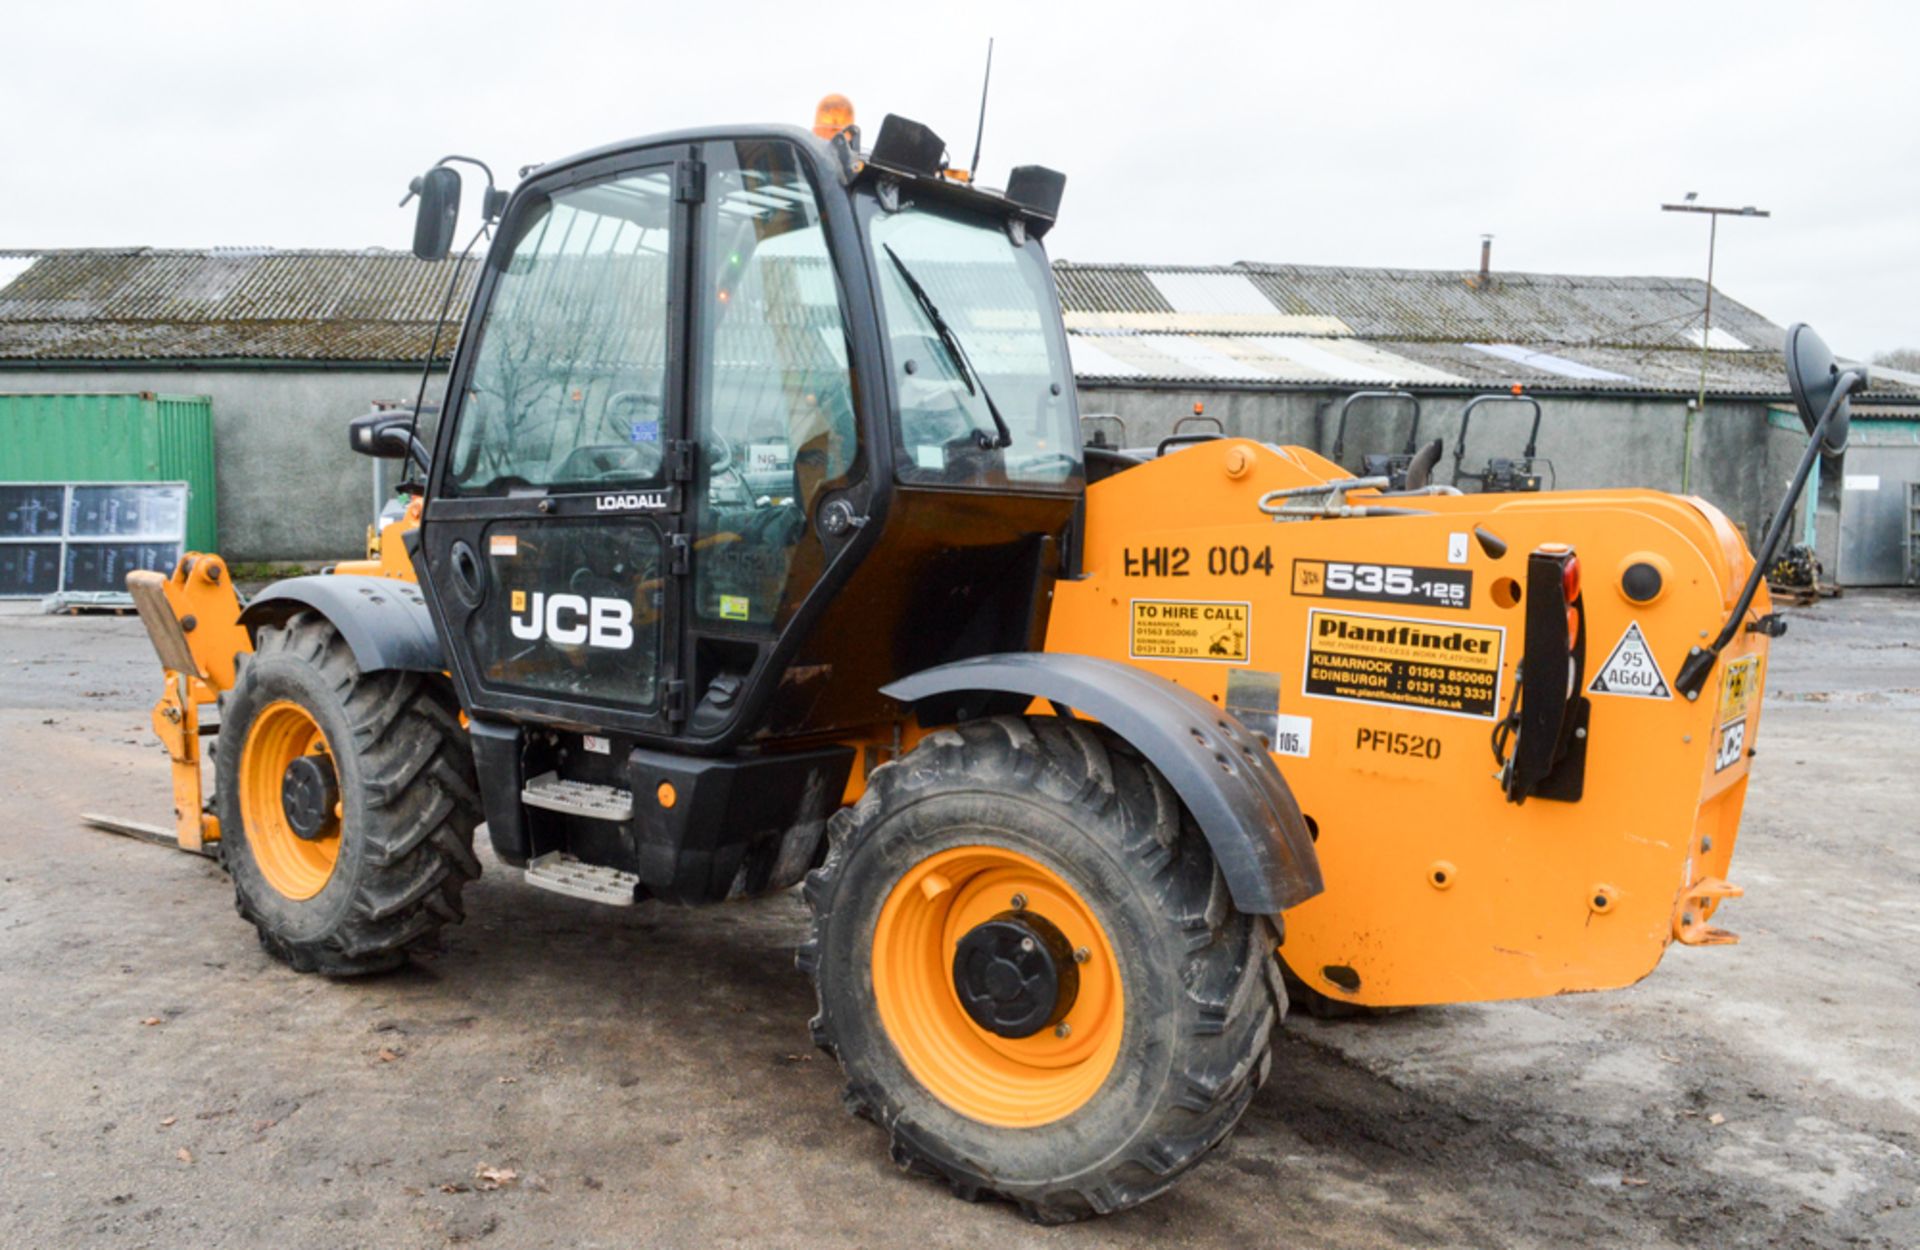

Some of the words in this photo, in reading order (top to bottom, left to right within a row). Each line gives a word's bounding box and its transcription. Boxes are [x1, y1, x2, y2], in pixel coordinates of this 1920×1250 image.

[596, 494, 667, 510] LOADALL
[1208, 545, 1274, 577] 004
[511, 592, 634, 650] JCB
[1137, 606, 1158, 618] TO
[1162, 606, 1199, 619] HIRE
[1203, 607, 1243, 621] CALL
[1136, 627, 1163, 636] 01563
[1318, 618, 1492, 655] Plantfinder
[1312, 654, 1393, 674] KILMARNOCK
[1408, 665, 1445, 679] 01563
[1448, 669, 1494, 686] 850060
[1622, 651, 1643, 668] 95
[1311, 668, 1388, 688] EDINBURGH
[1407, 679, 1435, 692] 0131
[1438, 683, 1461, 696] 333
[1464, 686, 1493, 701] 3331
[1335, 686, 1463, 710] www.plantfinderlimited.co.uk
[1279, 732, 1299, 752] 105
[1715, 721, 1745, 772] JCB
